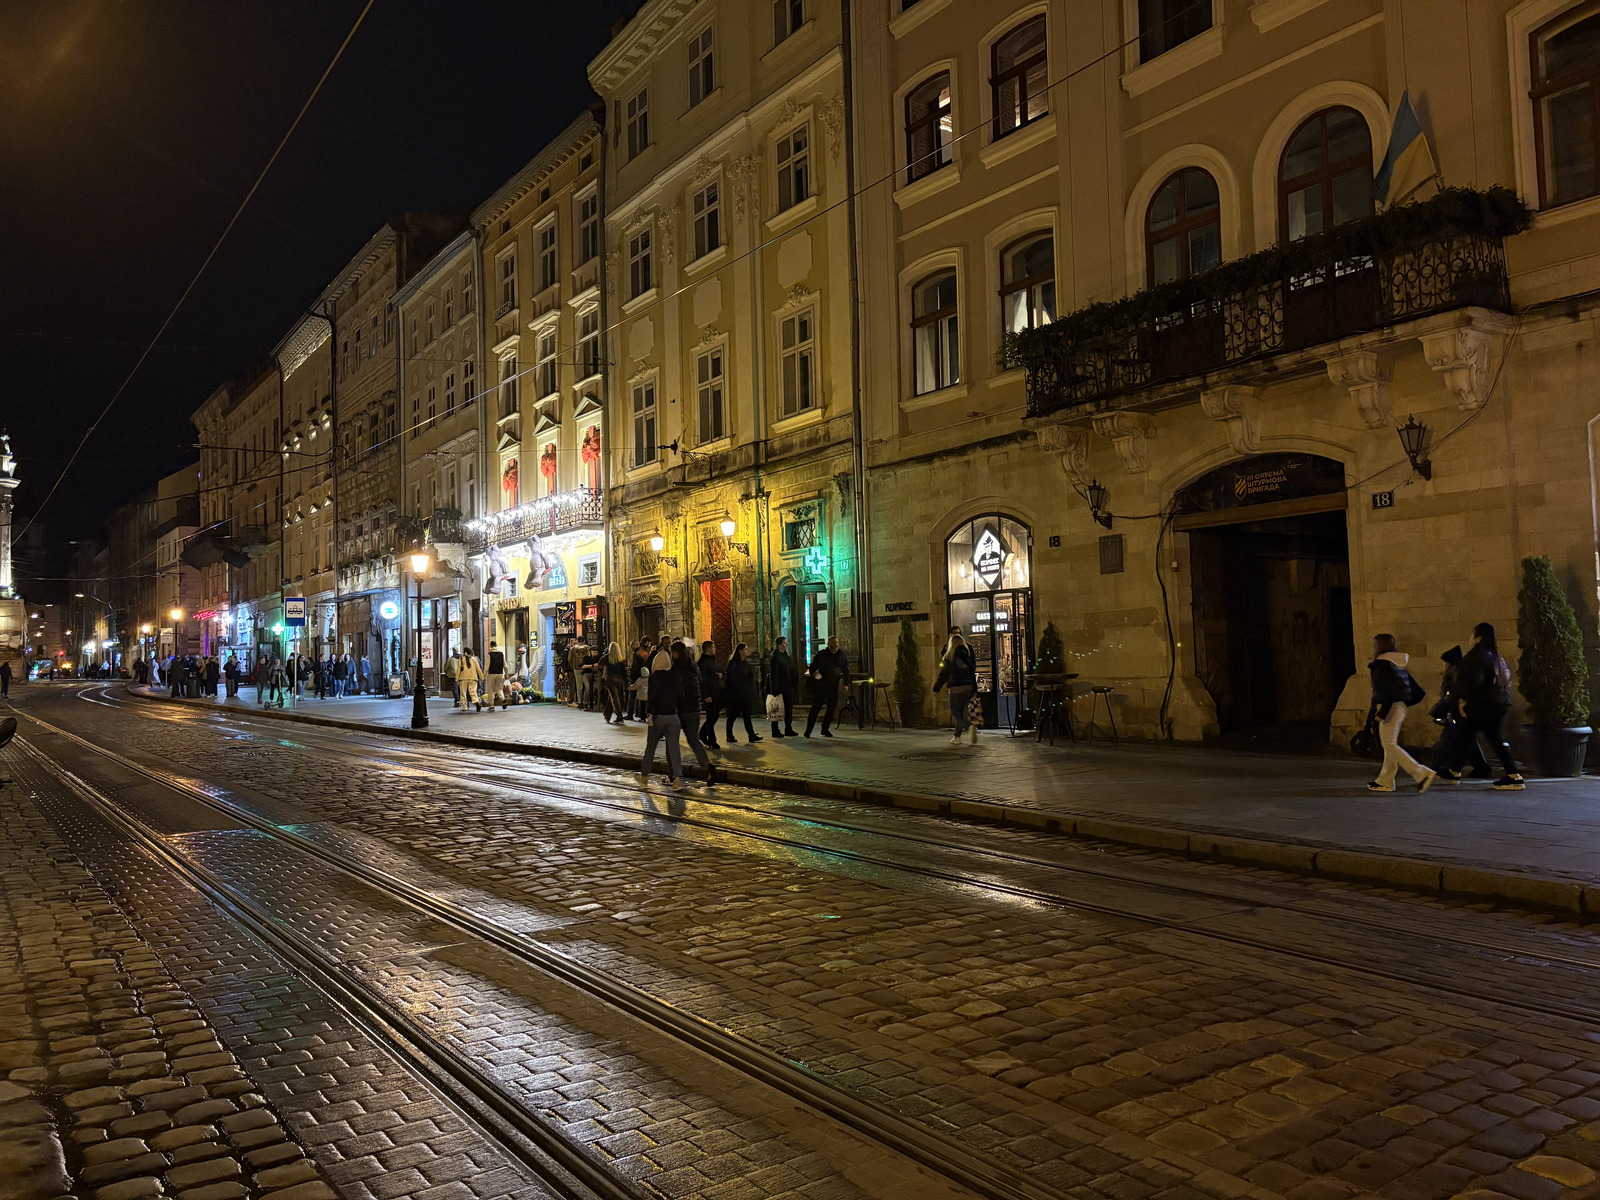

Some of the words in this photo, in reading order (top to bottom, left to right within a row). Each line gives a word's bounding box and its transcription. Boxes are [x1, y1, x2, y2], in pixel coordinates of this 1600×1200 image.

[1254, 469, 1285, 480] ОКРЕМА
[1246, 475, 1288, 488] ШТУРМОВА
[1247, 483, 1281, 494] БРИГАДА
[1375, 493, 1390, 507] 18
[1048, 536, 1060, 548] 18
[840, 560, 848, 569] 17
